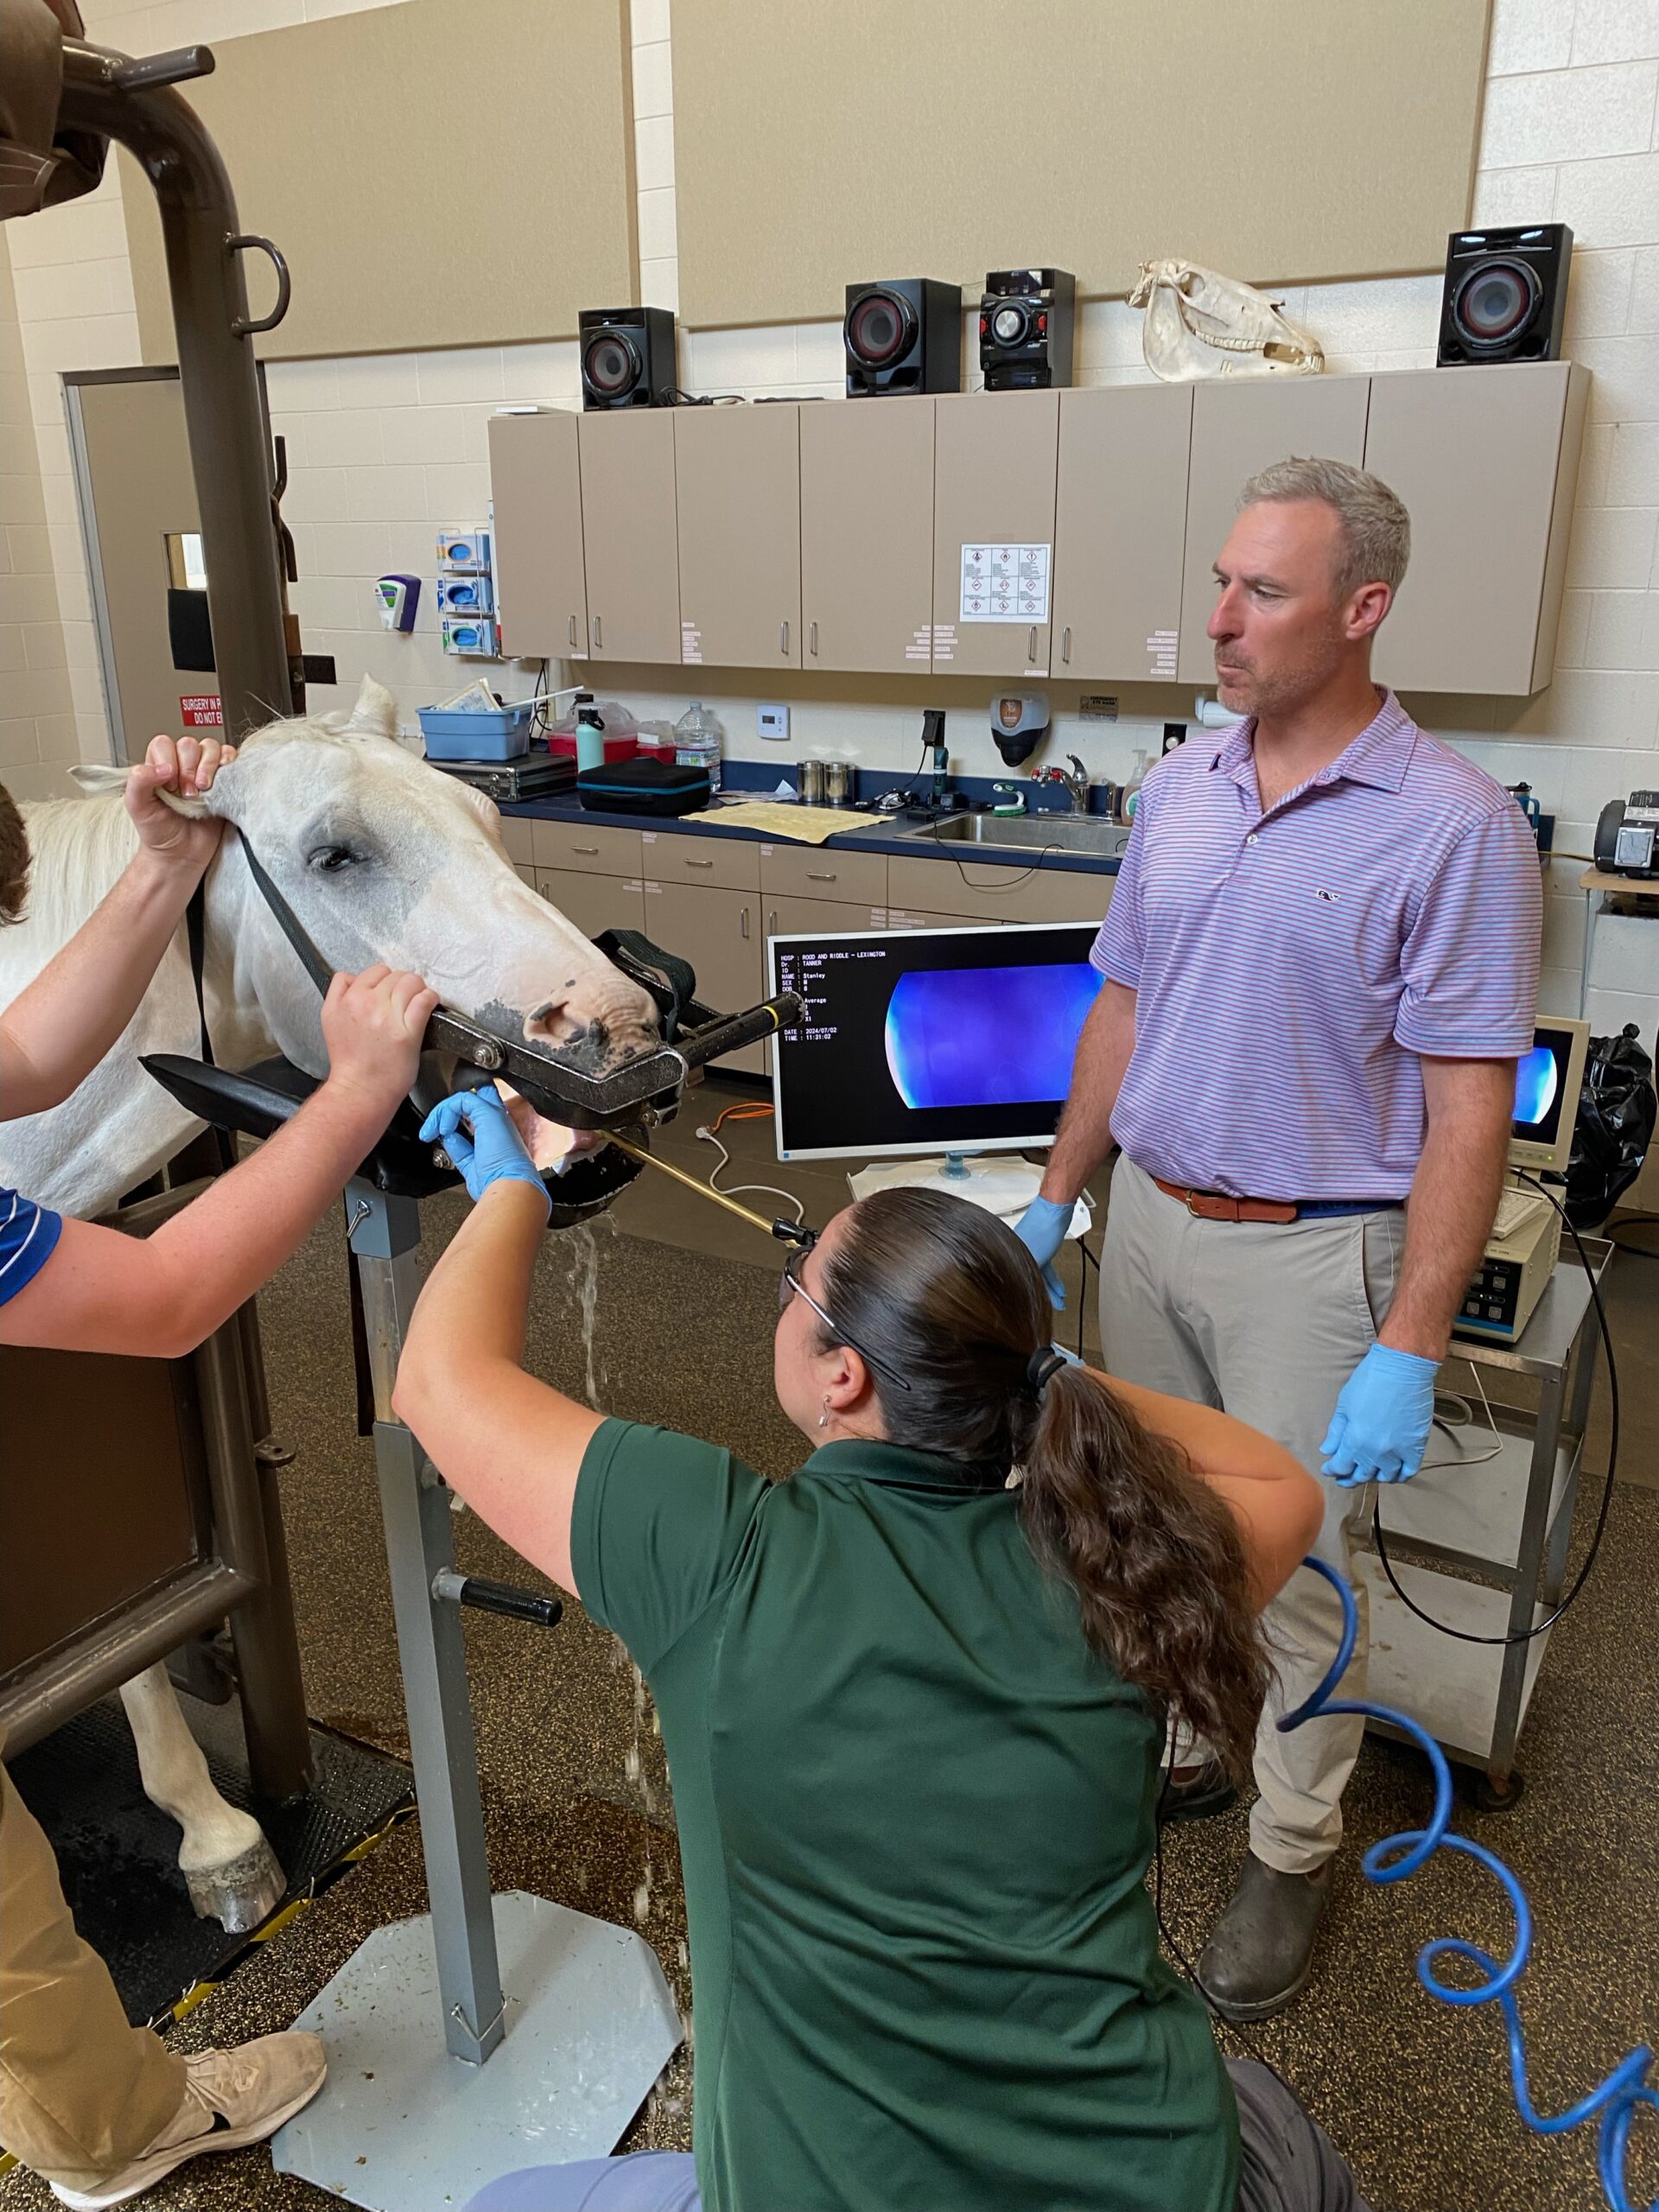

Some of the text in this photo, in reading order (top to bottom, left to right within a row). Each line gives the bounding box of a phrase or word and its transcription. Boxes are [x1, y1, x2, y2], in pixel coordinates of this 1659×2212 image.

[182, 698, 208, 710] SURGERY
[209, 698, 216, 709] IN
[194, 712, 203, 724] DO
[203, 712, 216, 724] NOT
